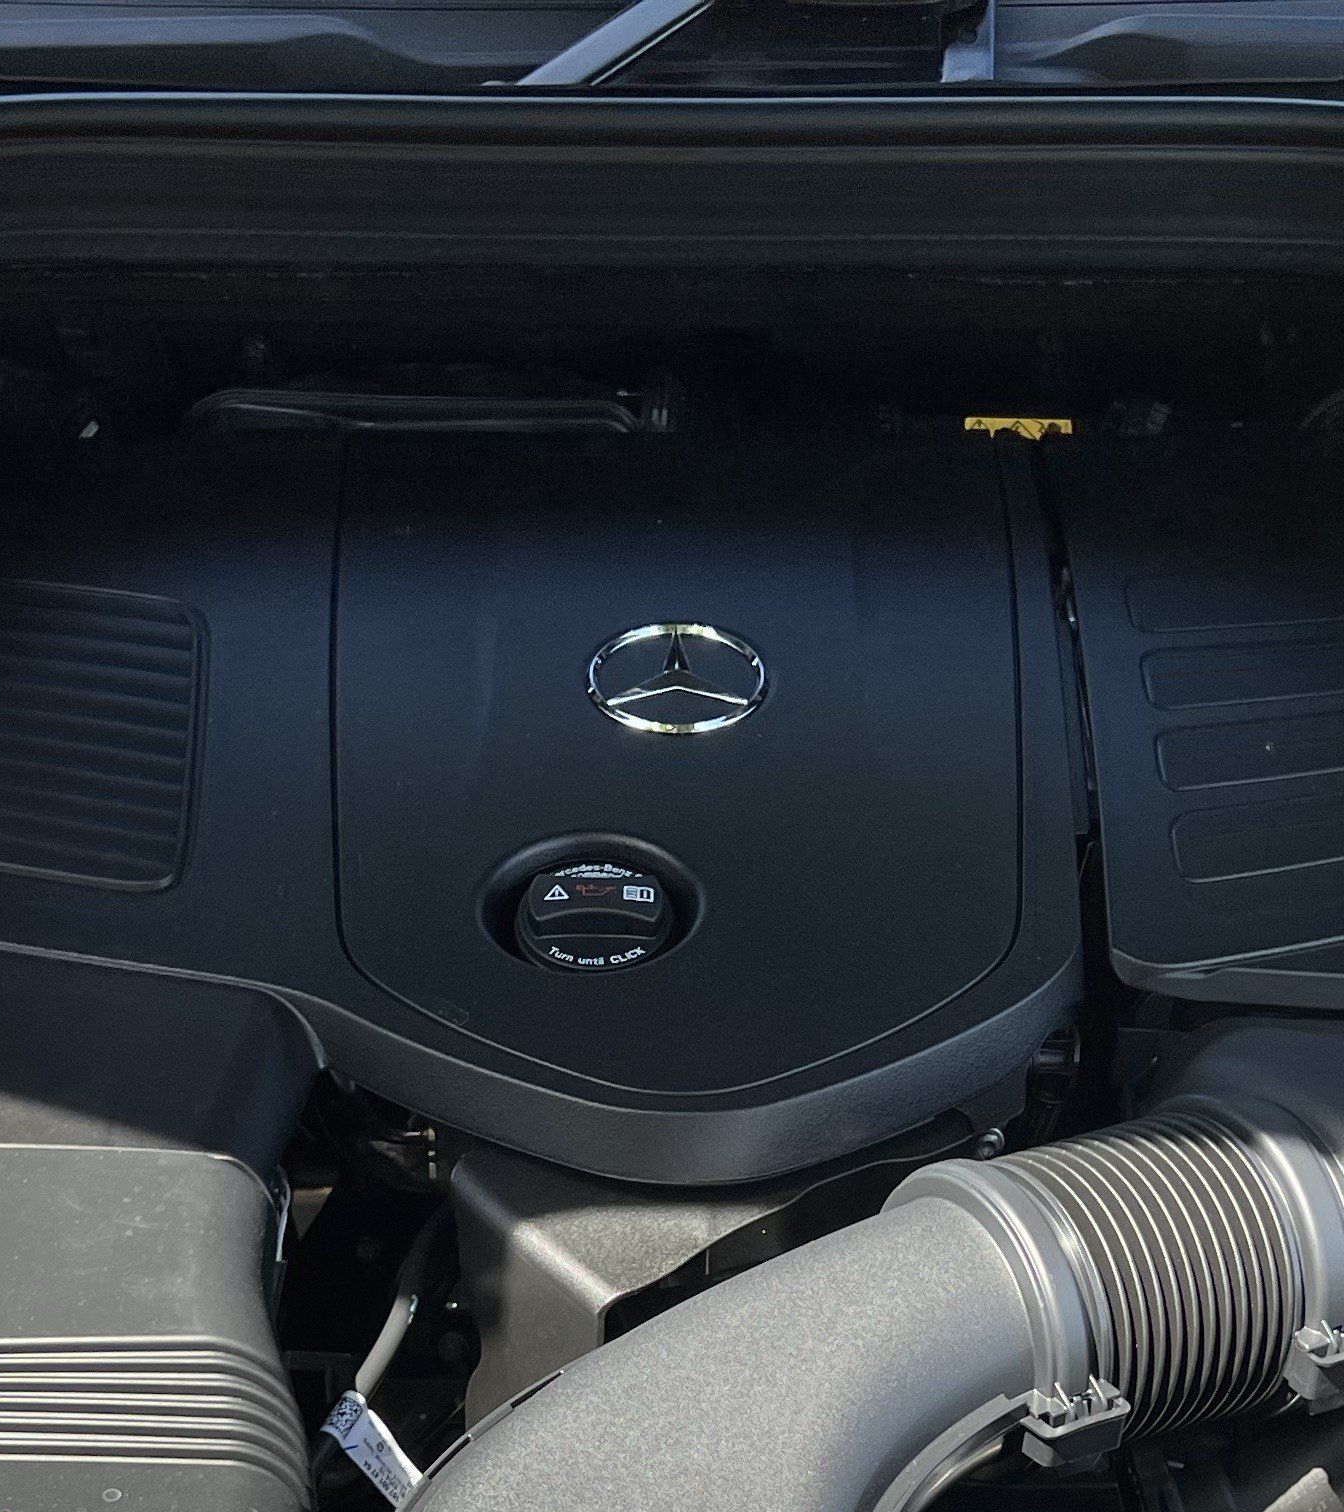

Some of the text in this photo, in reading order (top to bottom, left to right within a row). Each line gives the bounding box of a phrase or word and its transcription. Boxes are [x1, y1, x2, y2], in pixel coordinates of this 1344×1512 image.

[549, 945, 646, 966] Turn until CLICK
